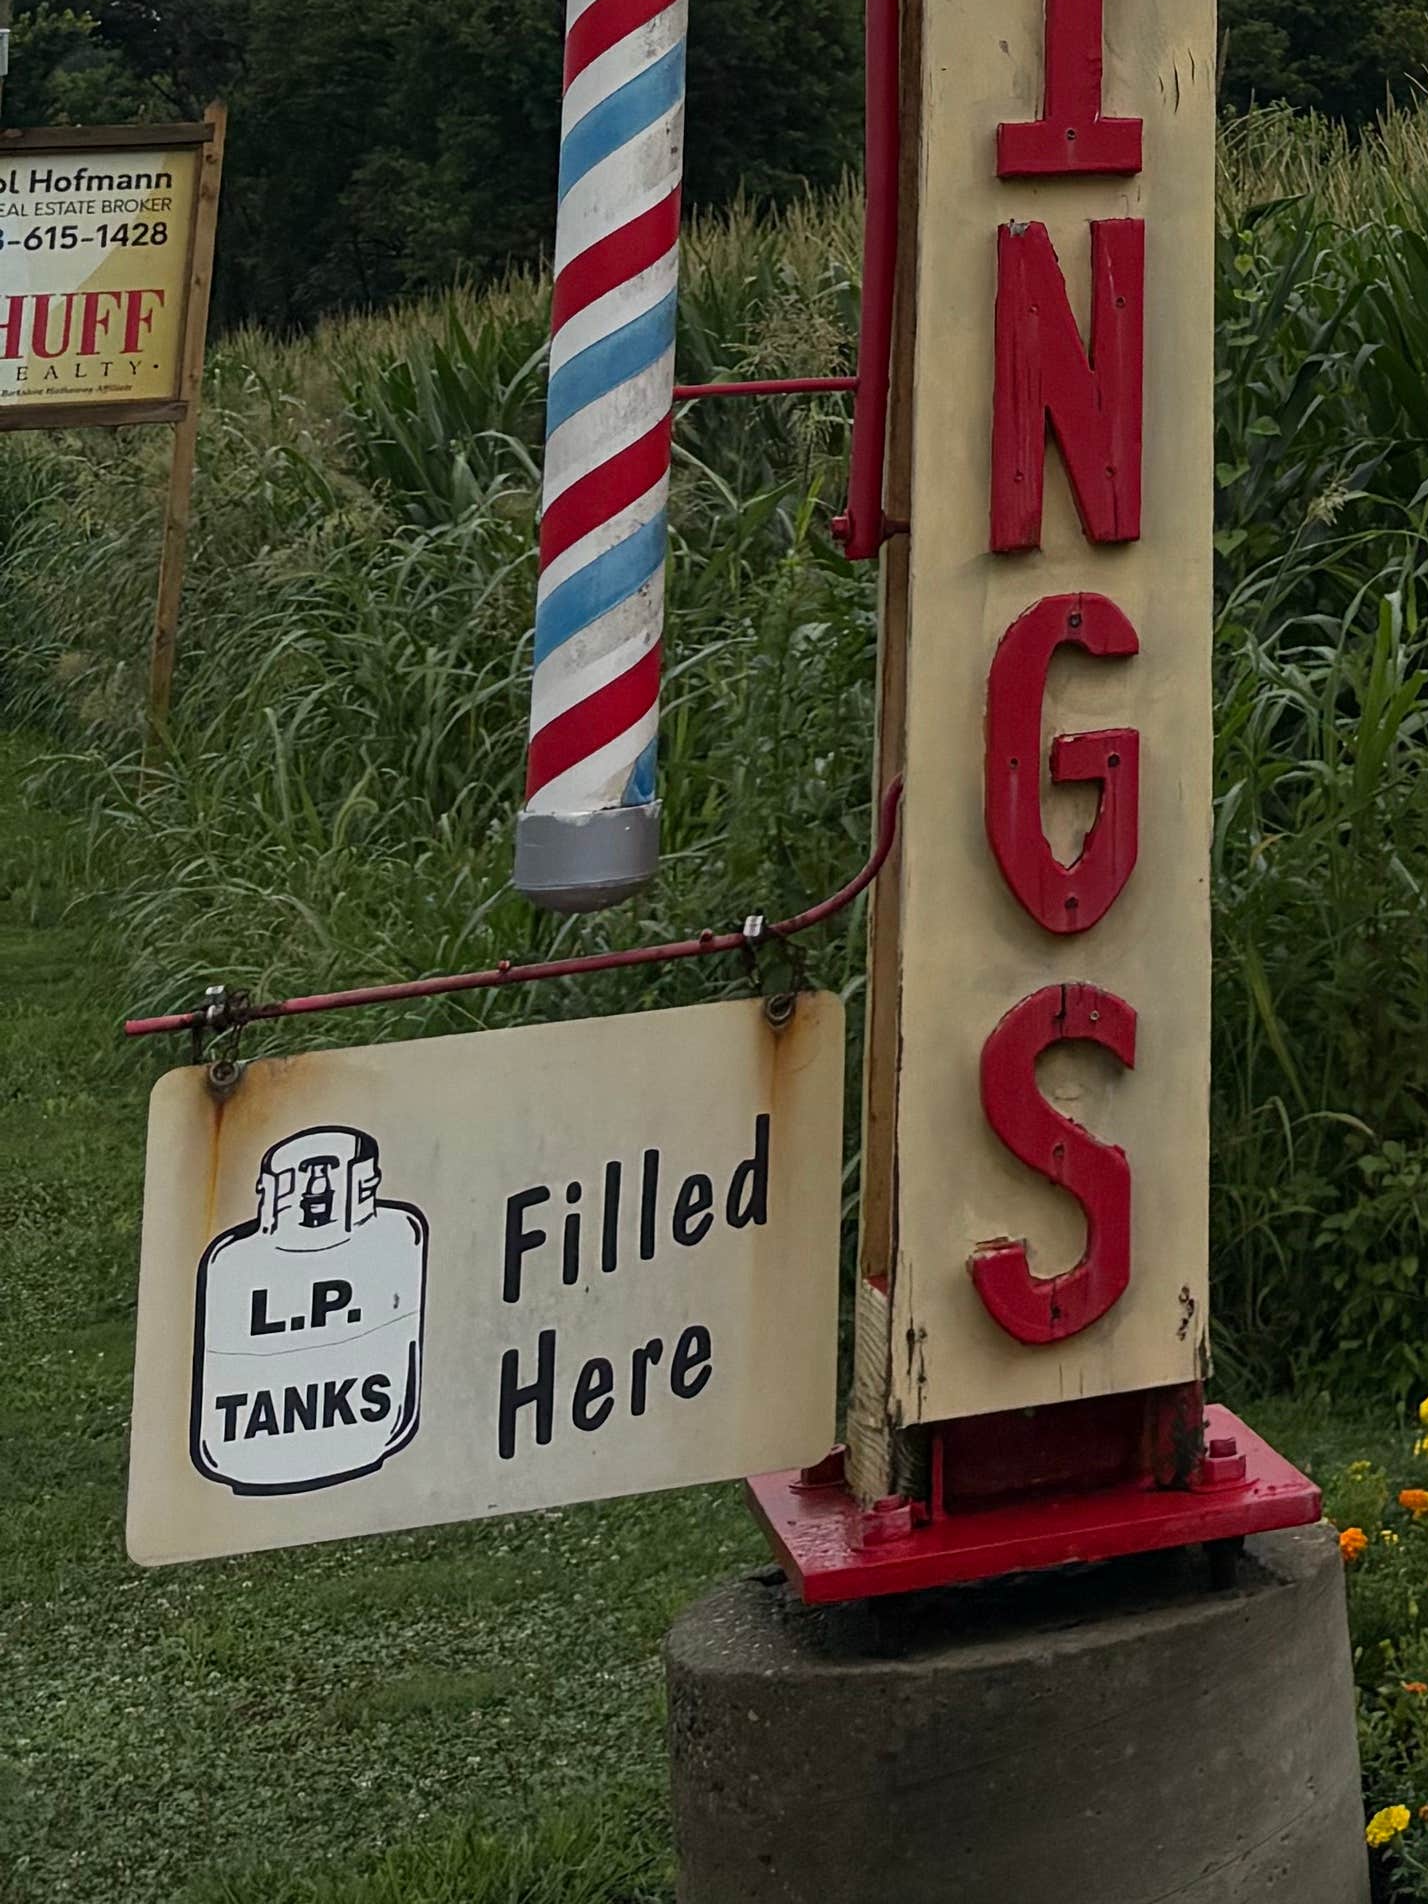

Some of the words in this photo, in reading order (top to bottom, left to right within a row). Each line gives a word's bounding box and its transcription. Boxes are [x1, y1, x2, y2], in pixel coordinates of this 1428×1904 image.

[29, 168, 172, 193] Hofmann
[34, 200, 96, 216] ESTATE
[101, 197, 172, 214] BROKER
[0, 222, 168, 251] -615-1428
[0, 289, 165, 360] HUFF
[503, 1114, 770, 1303] Filled
[250, 1280, 362, 1337] L.P.
[215, 1374, 392, 1442] TANKS
[499, 1325, 712, 1459] Here
